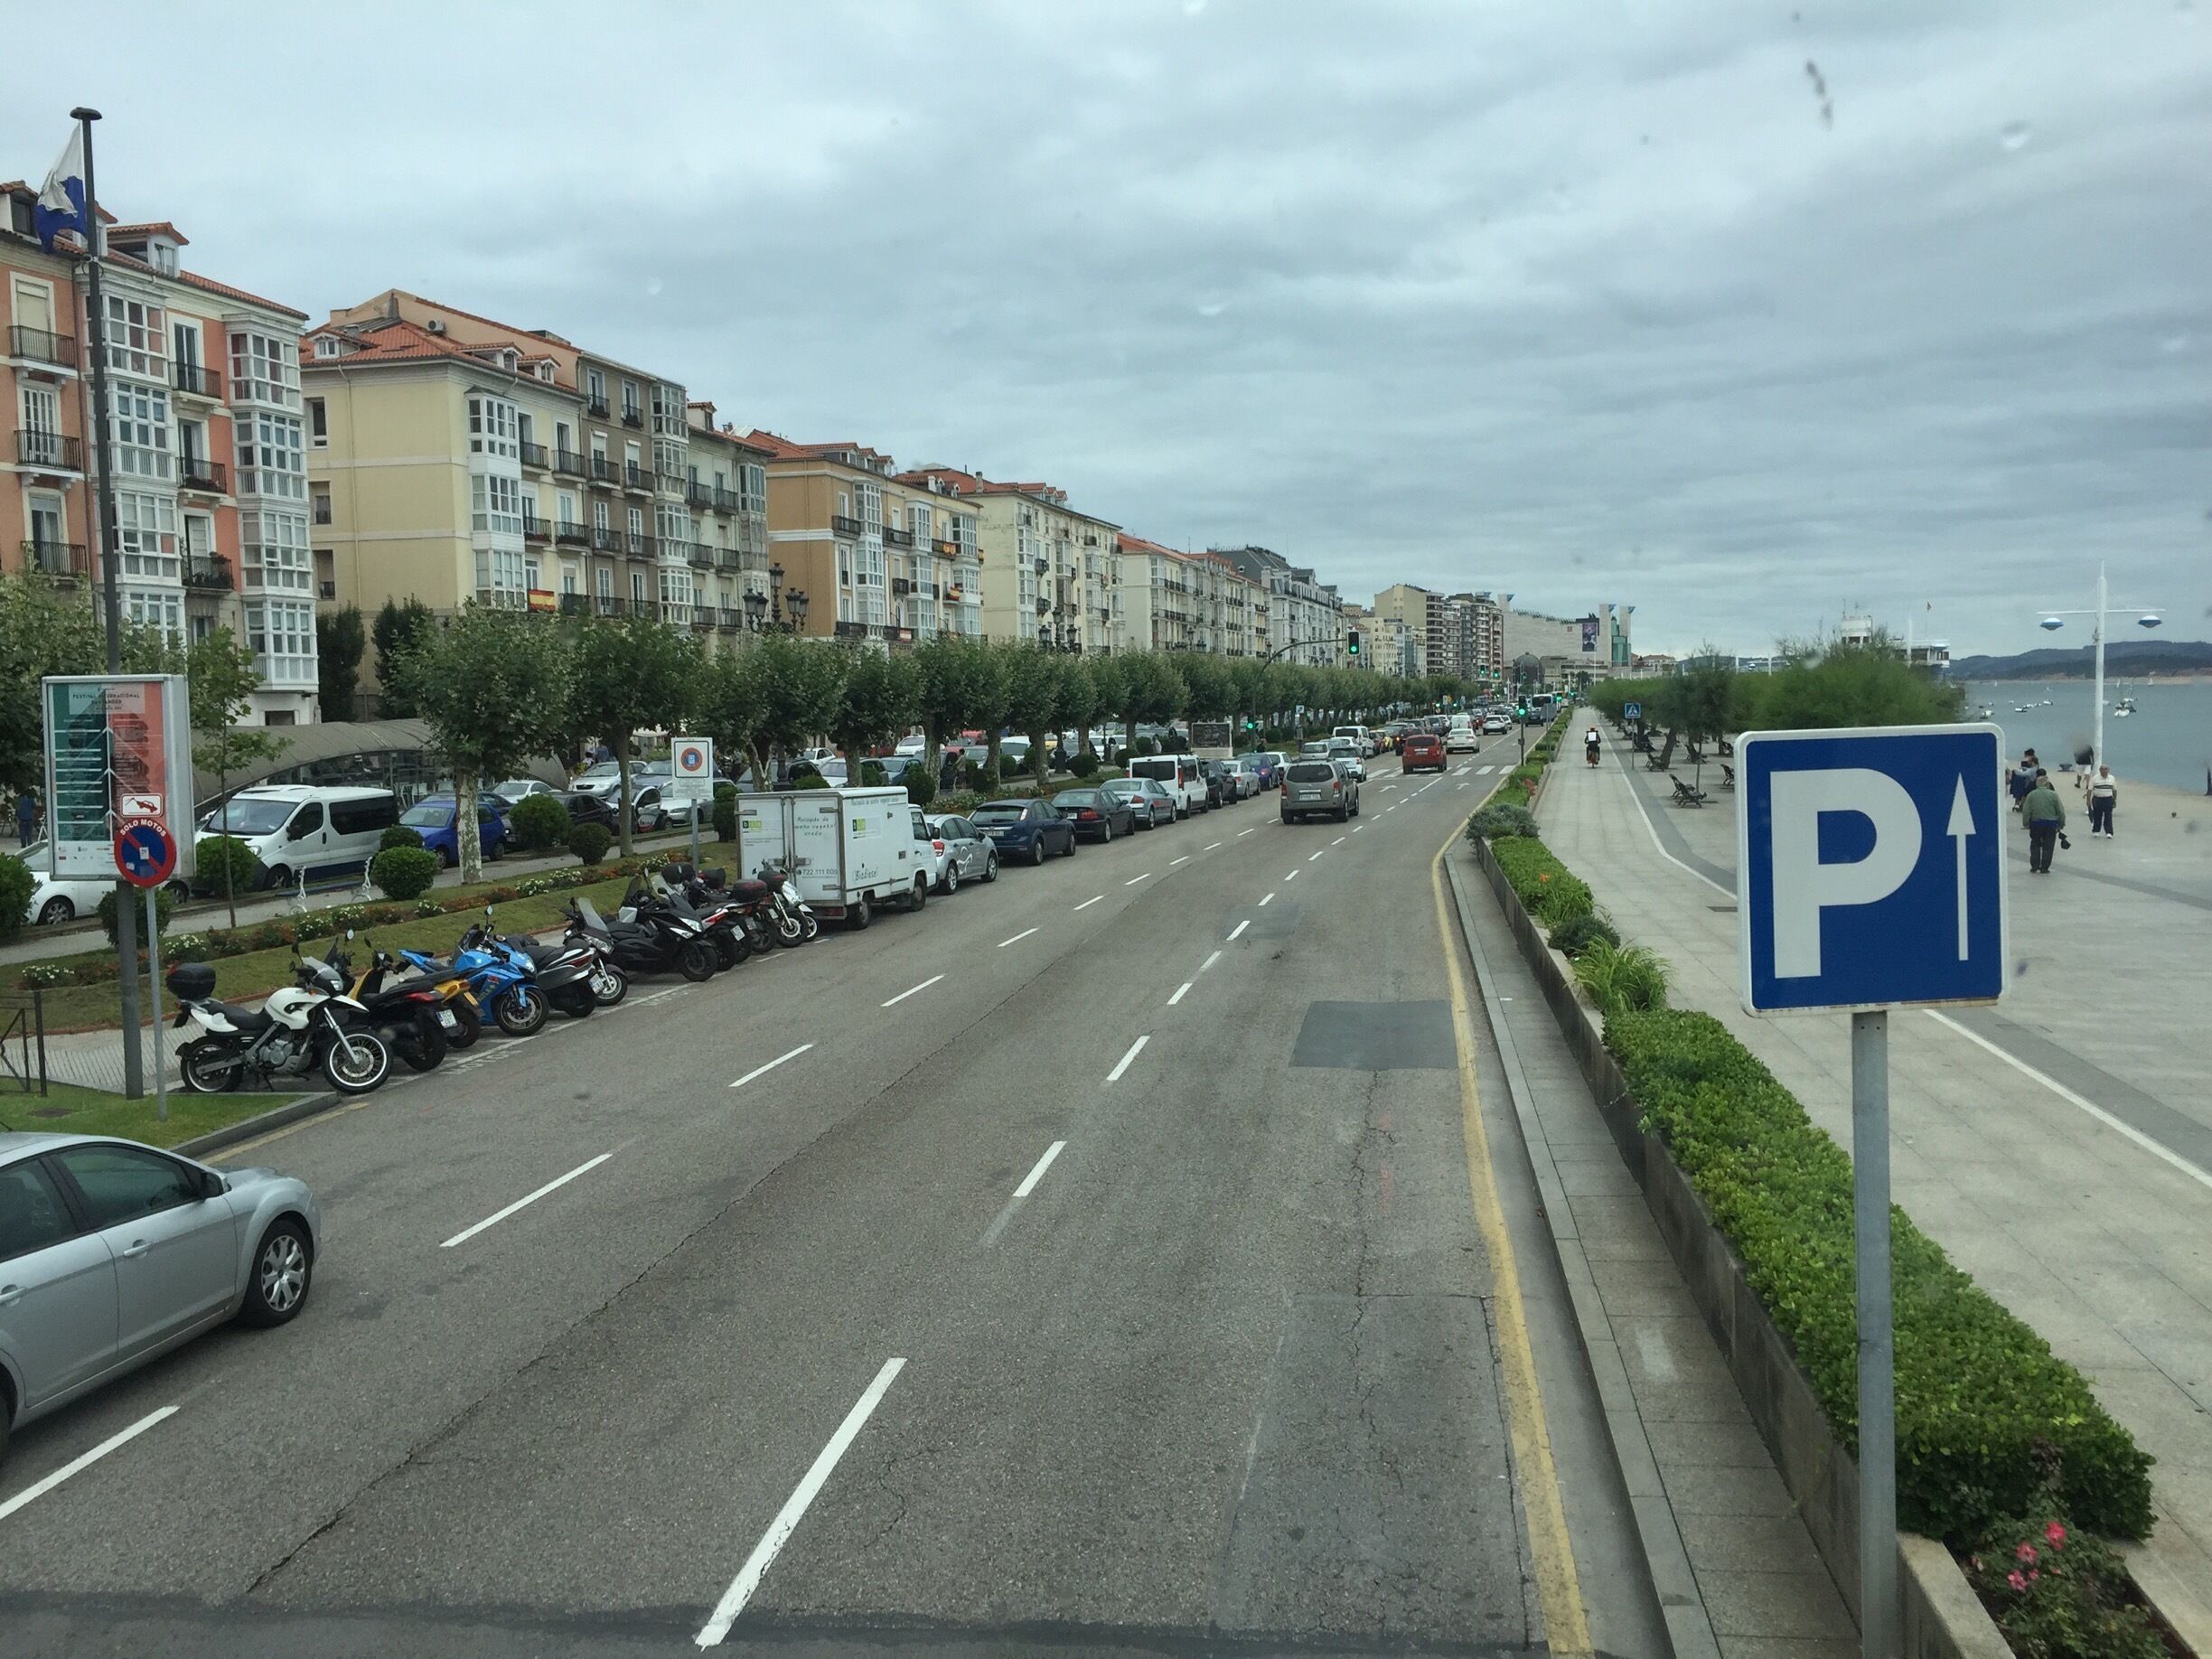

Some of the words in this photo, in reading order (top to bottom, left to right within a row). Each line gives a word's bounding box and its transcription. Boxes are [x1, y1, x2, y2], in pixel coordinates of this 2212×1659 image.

[120, 820, 139, 836] SOLO
[140, 819, 167, 837] MOTOS
[1770, 767, 1923, 979] P
